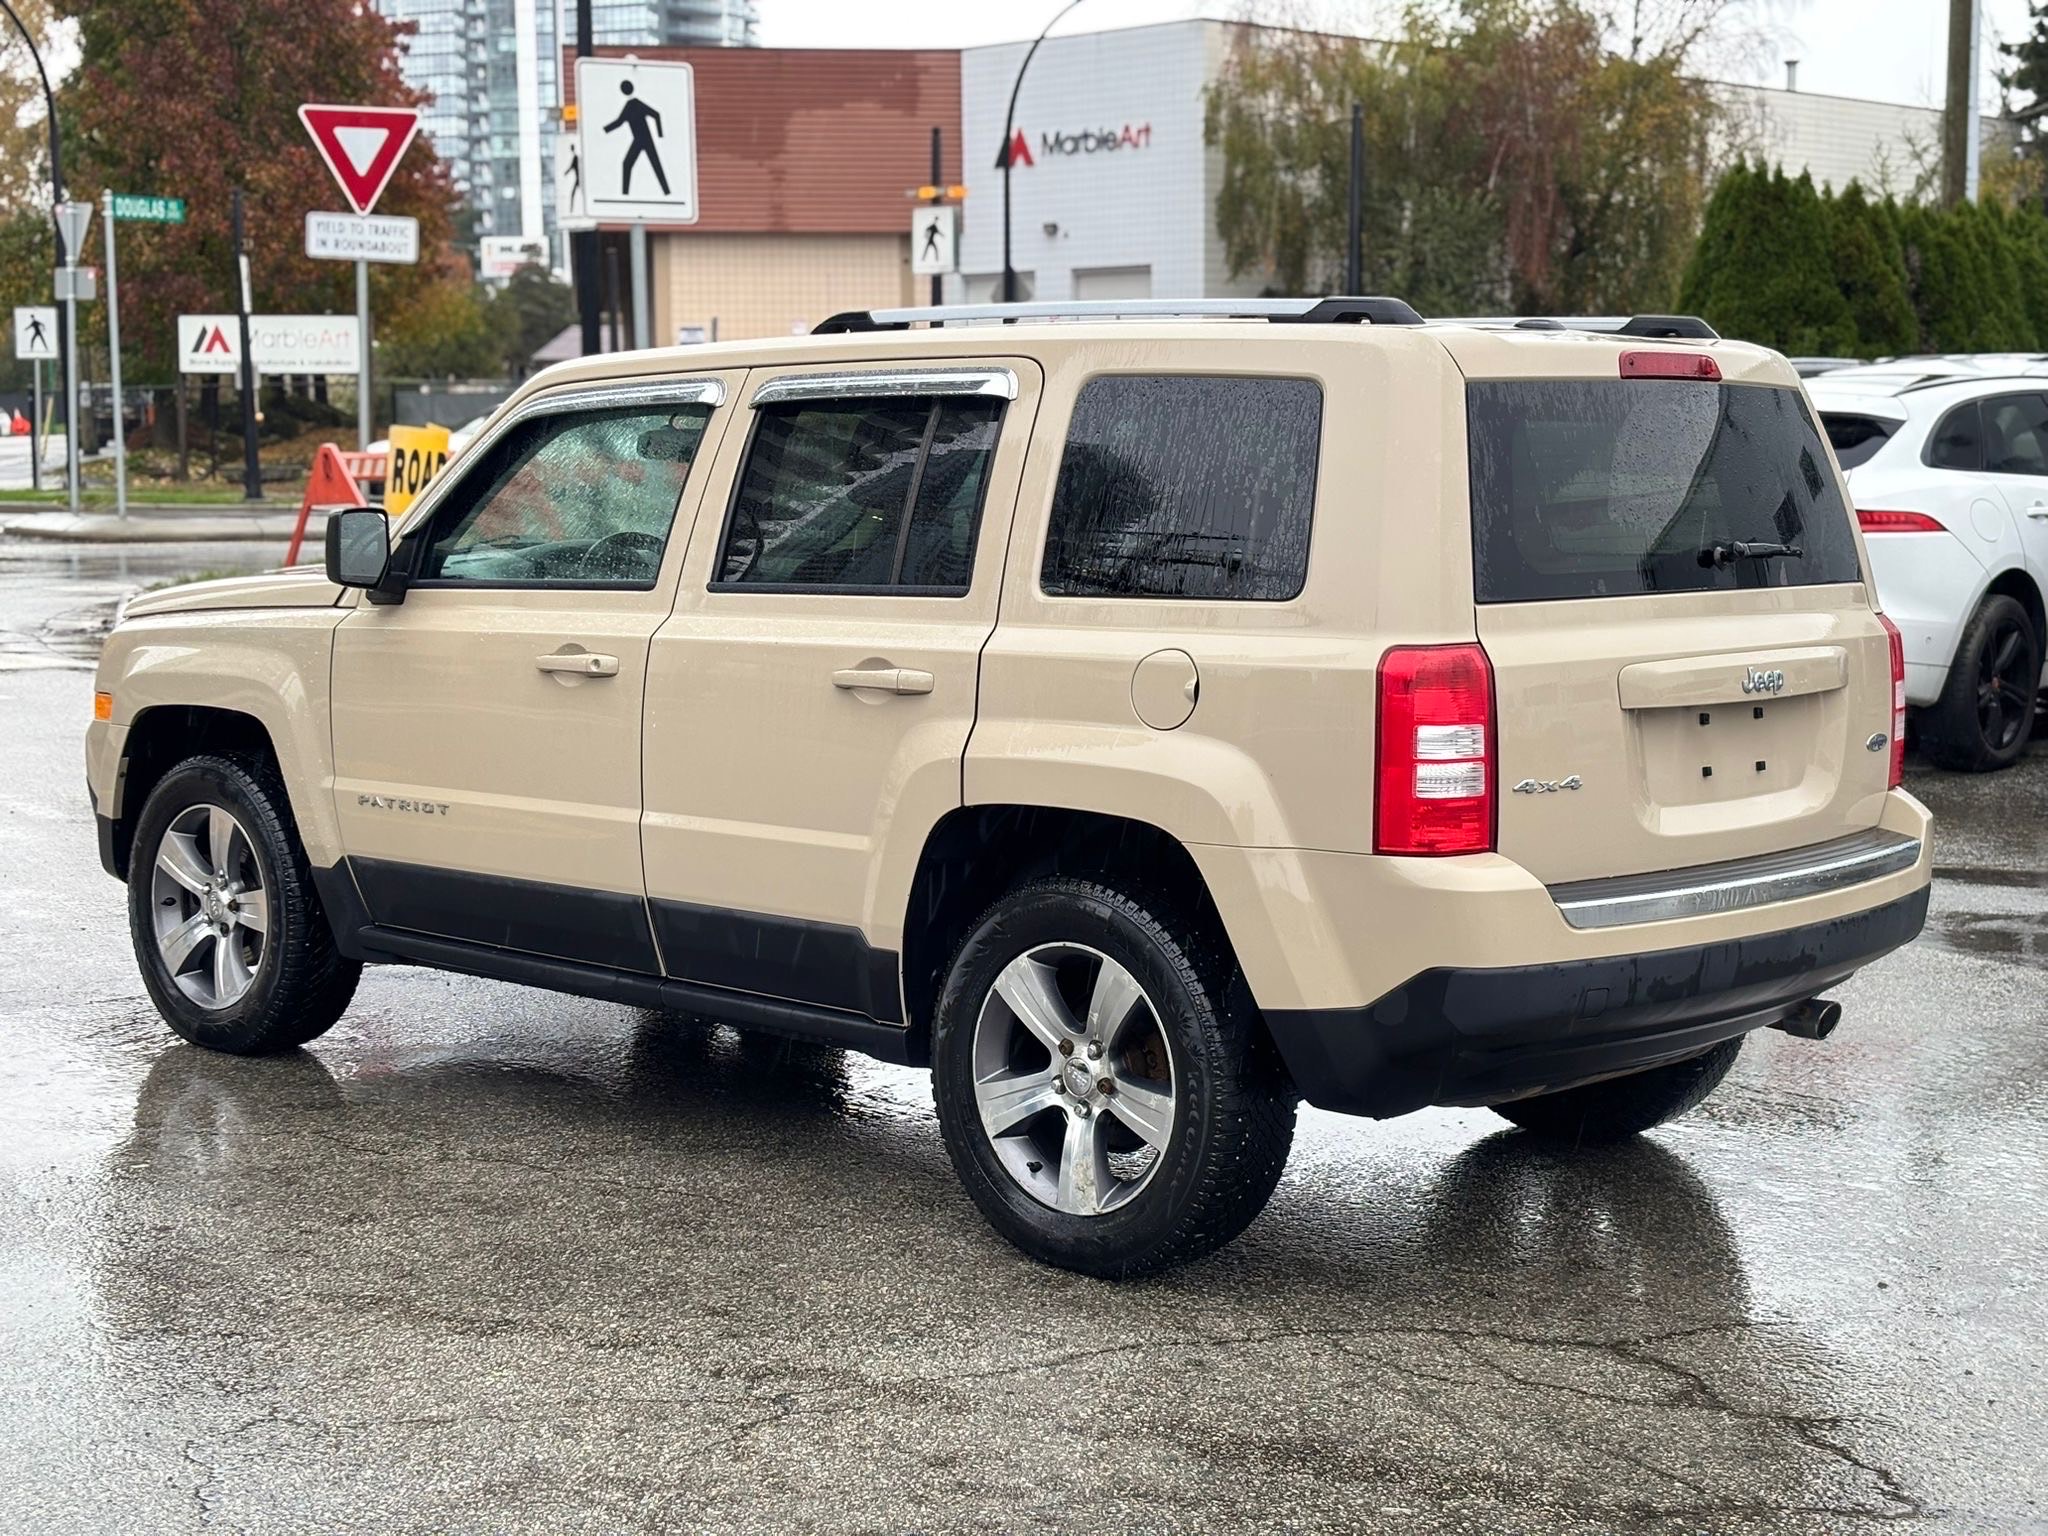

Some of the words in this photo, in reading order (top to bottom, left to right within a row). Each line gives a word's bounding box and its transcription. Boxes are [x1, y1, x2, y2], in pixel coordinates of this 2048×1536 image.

[1041, 123, 1151, 156] MarbleArt
[114, 196, 166, 219] DOUGLAS
[315, 220, 346, 234] YIELD
[351, 221, 365, 235] TO
[368, 223, 410, 239] TRAFFIC
[315, 238, 328, 249] IN
[333, 238, 410, 254] ROUNDABOUT
[1741, 666, 1784, 696] Jeep
[1512, 774, 1584, 794] 4x4
[357, 794, 450, 816] PATRIOT
